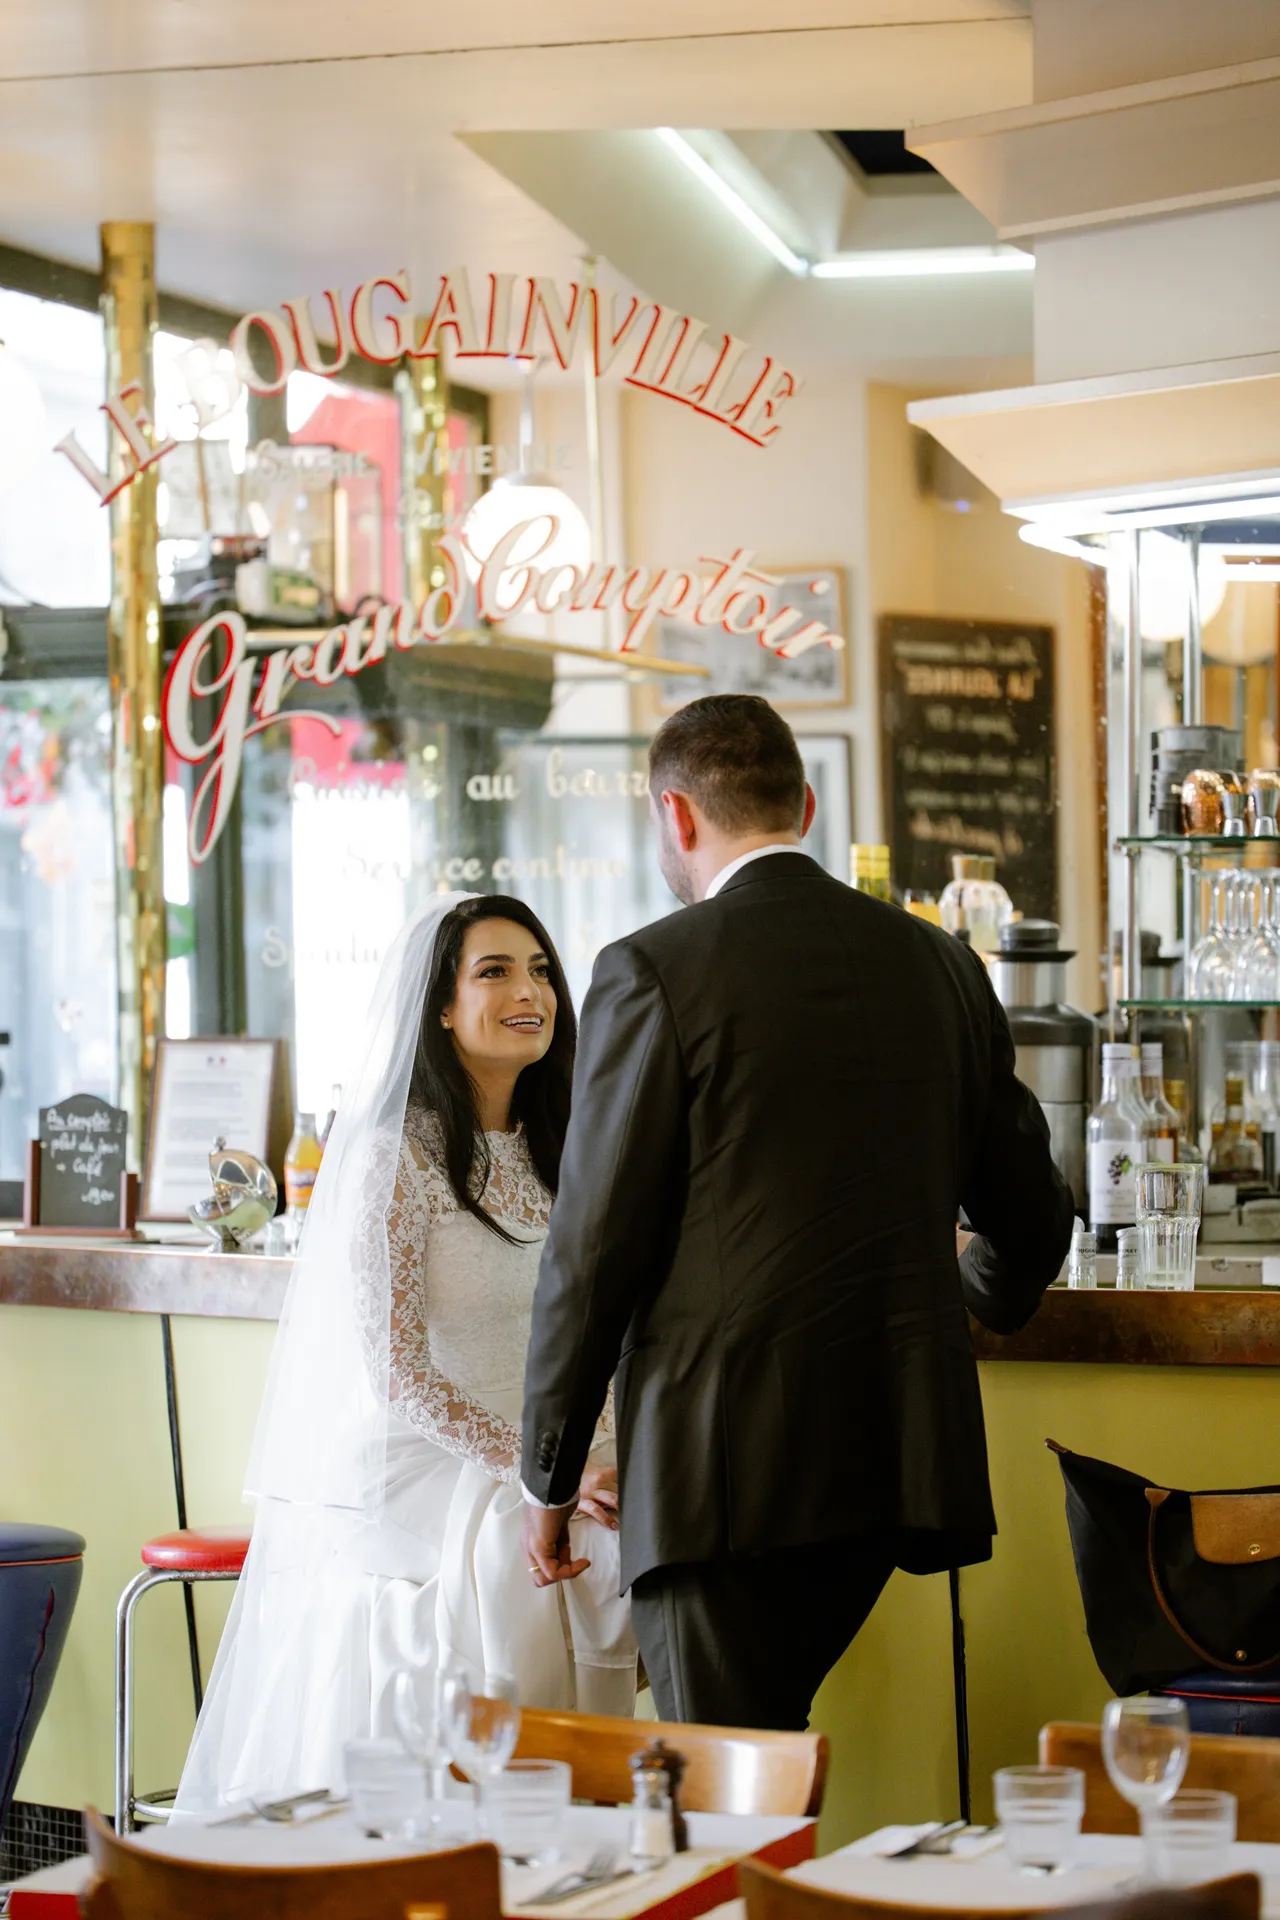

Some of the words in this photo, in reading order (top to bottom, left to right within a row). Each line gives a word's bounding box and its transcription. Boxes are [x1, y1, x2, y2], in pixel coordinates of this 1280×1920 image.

[52, 377, 179, 507] LE
[172, 267, 804, 447] BOUGAINVILLE
[161, 533, 468, 865] Grand
[464, 513, 845, 660] Comptoir
[465, 774, 520, 801] au
